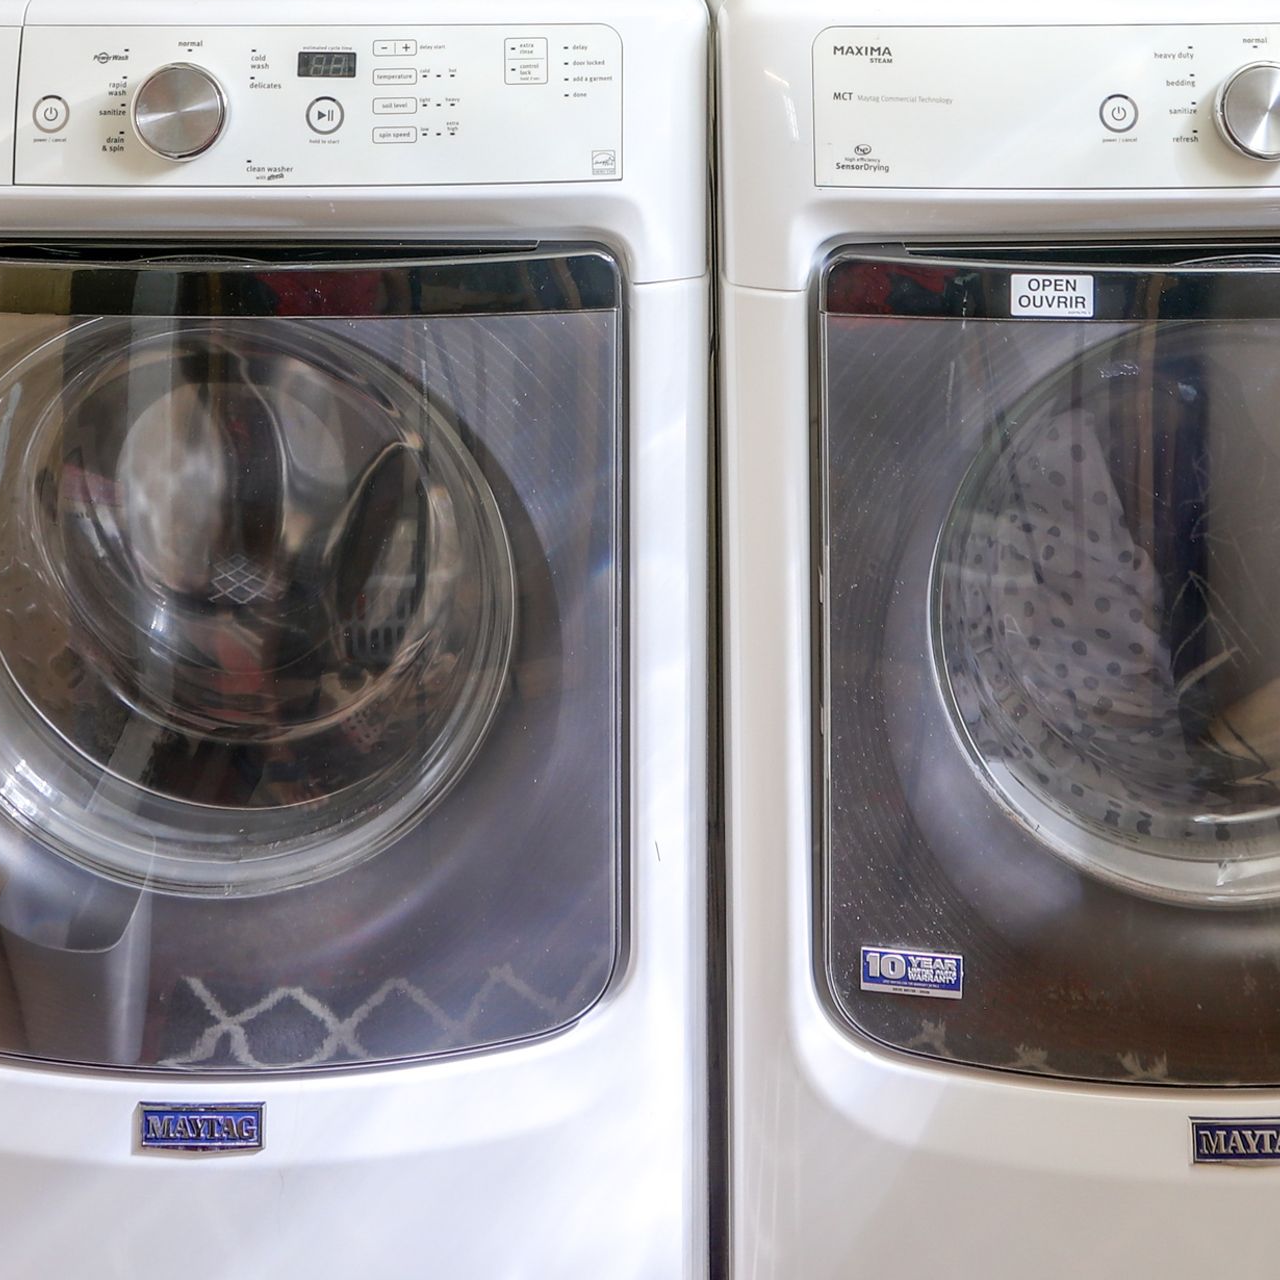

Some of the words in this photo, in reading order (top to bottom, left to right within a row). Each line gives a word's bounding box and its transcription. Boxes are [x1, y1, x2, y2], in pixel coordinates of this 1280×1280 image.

[833, 46, 892, 56] MAXIMA
[1154, 52, 1176, 60] heavy
[1177, 52, 1194, 60] duty
[108, 81, 127, 89] rapid
[833, 92, 853, 101] MCT
[857, 95, 880, 103] Maytag
[881, 95, 916, 103] Commercial
[918, 96, 952, 104] Technology
[106, 136, 124, 144] drain
[109, 145, 124, 153] spin
[835, 162, 889, 173] SensorDrying
[1028, 278, 1077, 292] OPEN
[1018, 295, 1086, 309] OUVRIR
[866, 952, 905, 979] 10
[908, 956, 957, 971] YEAR
[908, 972, 957, 984] WARRANTY
[147, 1115, 257, 1141] MAYTAG
